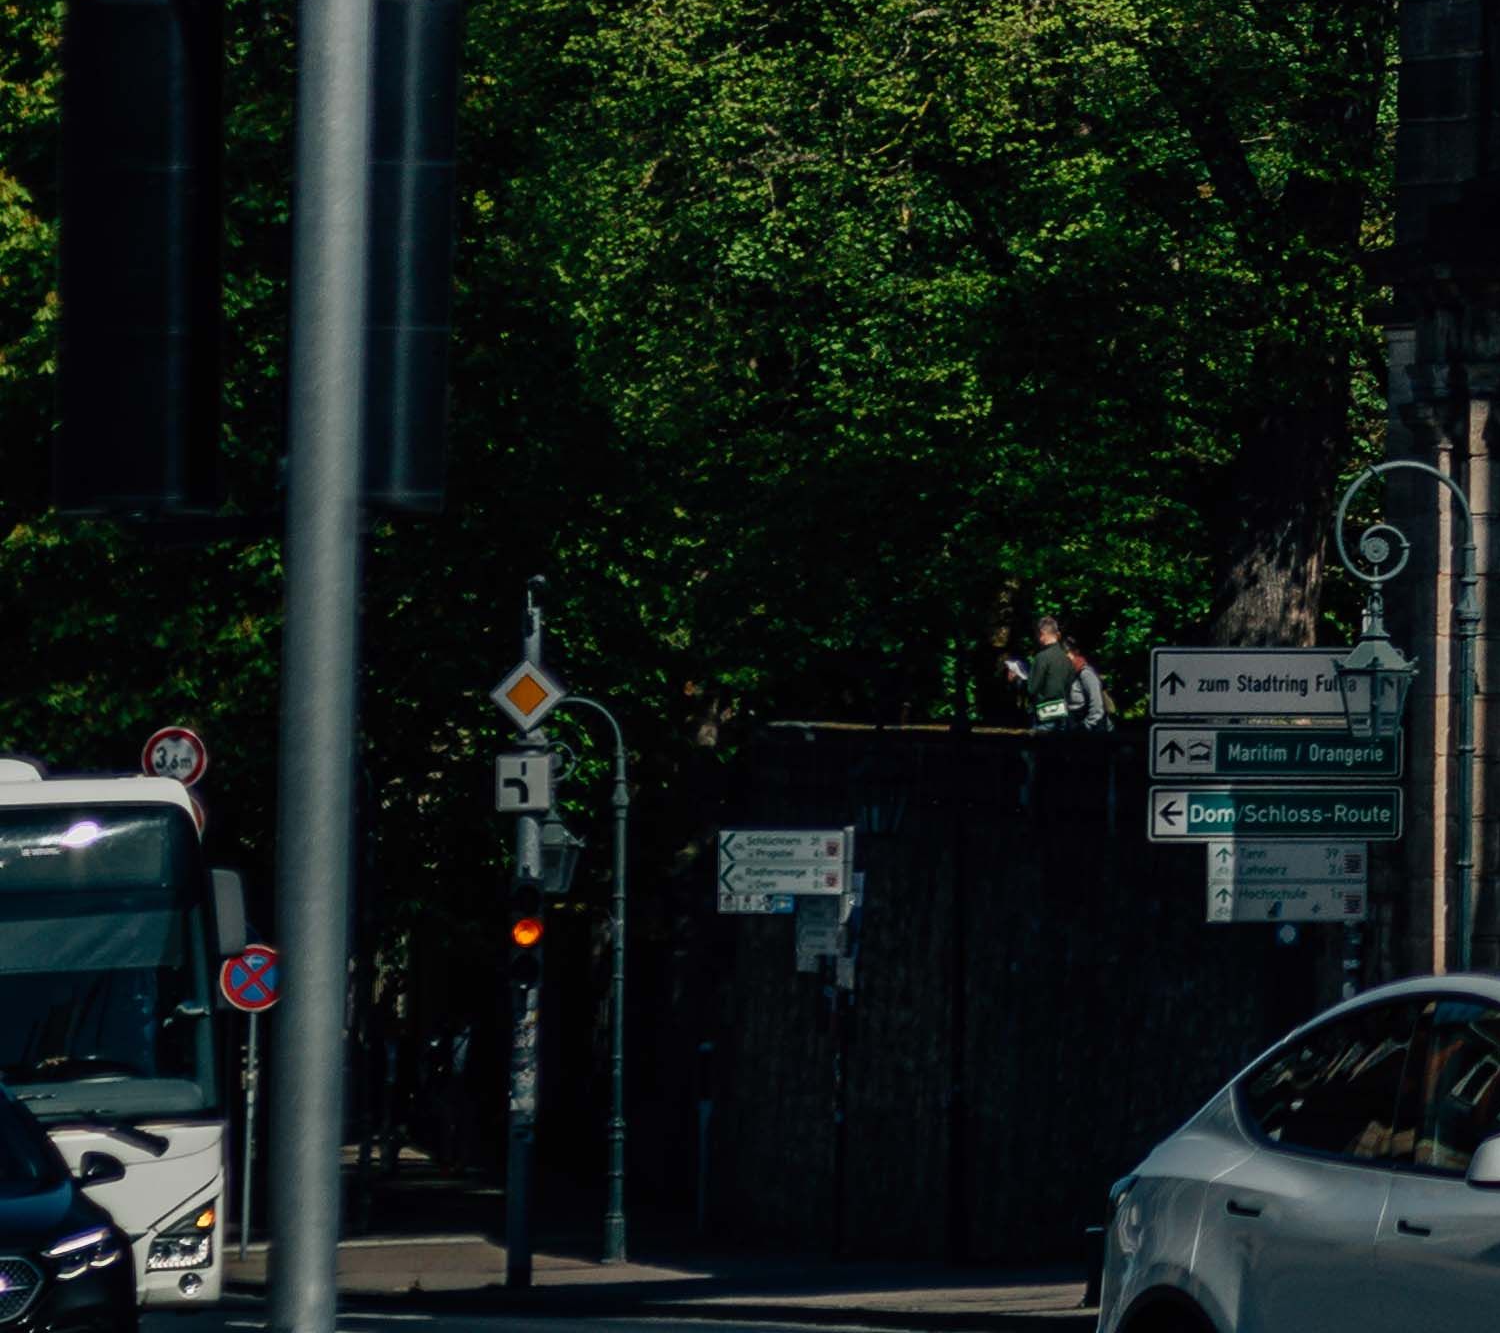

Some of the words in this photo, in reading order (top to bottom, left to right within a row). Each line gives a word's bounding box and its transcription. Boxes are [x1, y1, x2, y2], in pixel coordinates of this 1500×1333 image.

[1197, 678, 1230, 693] zum
[1237, 674, 1309, 696] Stadtring
[1316, 674, 1357, 693] Fula
[1228, 743, 1288, 762] Maritim
[1296, 743, 1302, 762] /
[1308, 743, 1385, 766] Orangerie
